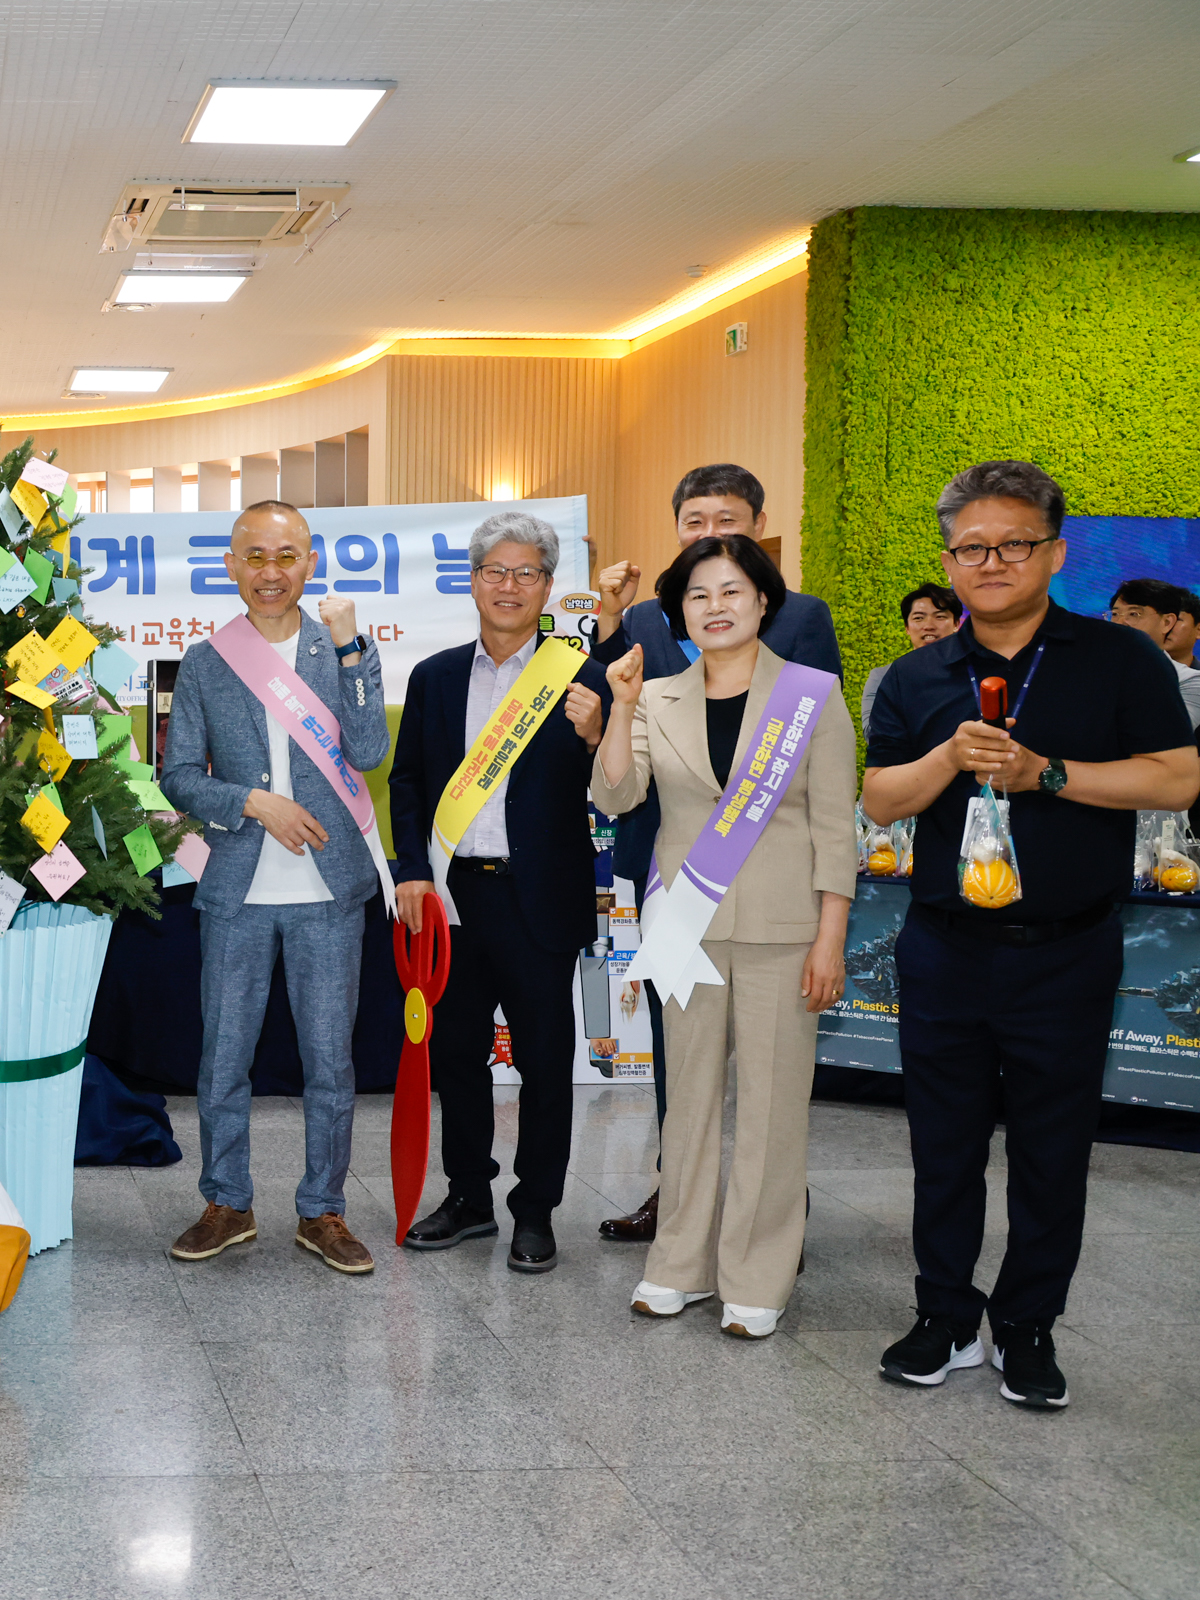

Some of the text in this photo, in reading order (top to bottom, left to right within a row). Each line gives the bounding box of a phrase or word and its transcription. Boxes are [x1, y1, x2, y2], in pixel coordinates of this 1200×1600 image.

[70, 535, 156, 595] 계
[187, 533, 400, 595] 금의
[565, 599, 593, 609] 남학생
[267, 676, 291, 701] 담배
[284, 695, 309, 720] 알고
[301, 715, 334, 749] 마시는
[449, 698, 523, 801] 담배속에 사라진다
[477, 685, 554, 791] 너와 나의 밝은미래
[714, 717, 785, 838] 금연하면 평생행복
[745, 696, 816, 823] 흡연하면 잠시 기쁨
[601, 829, 612, 837] 신장
[624, 909, 635, 917] 혈관
[832, 1001, 851, 1010] ay,
[852, 999, 890, 1013] Plastic
[1125, 1030, 1163, 1046] Away,
[1150, 1046, 1179, 1056] 플라스틱은
